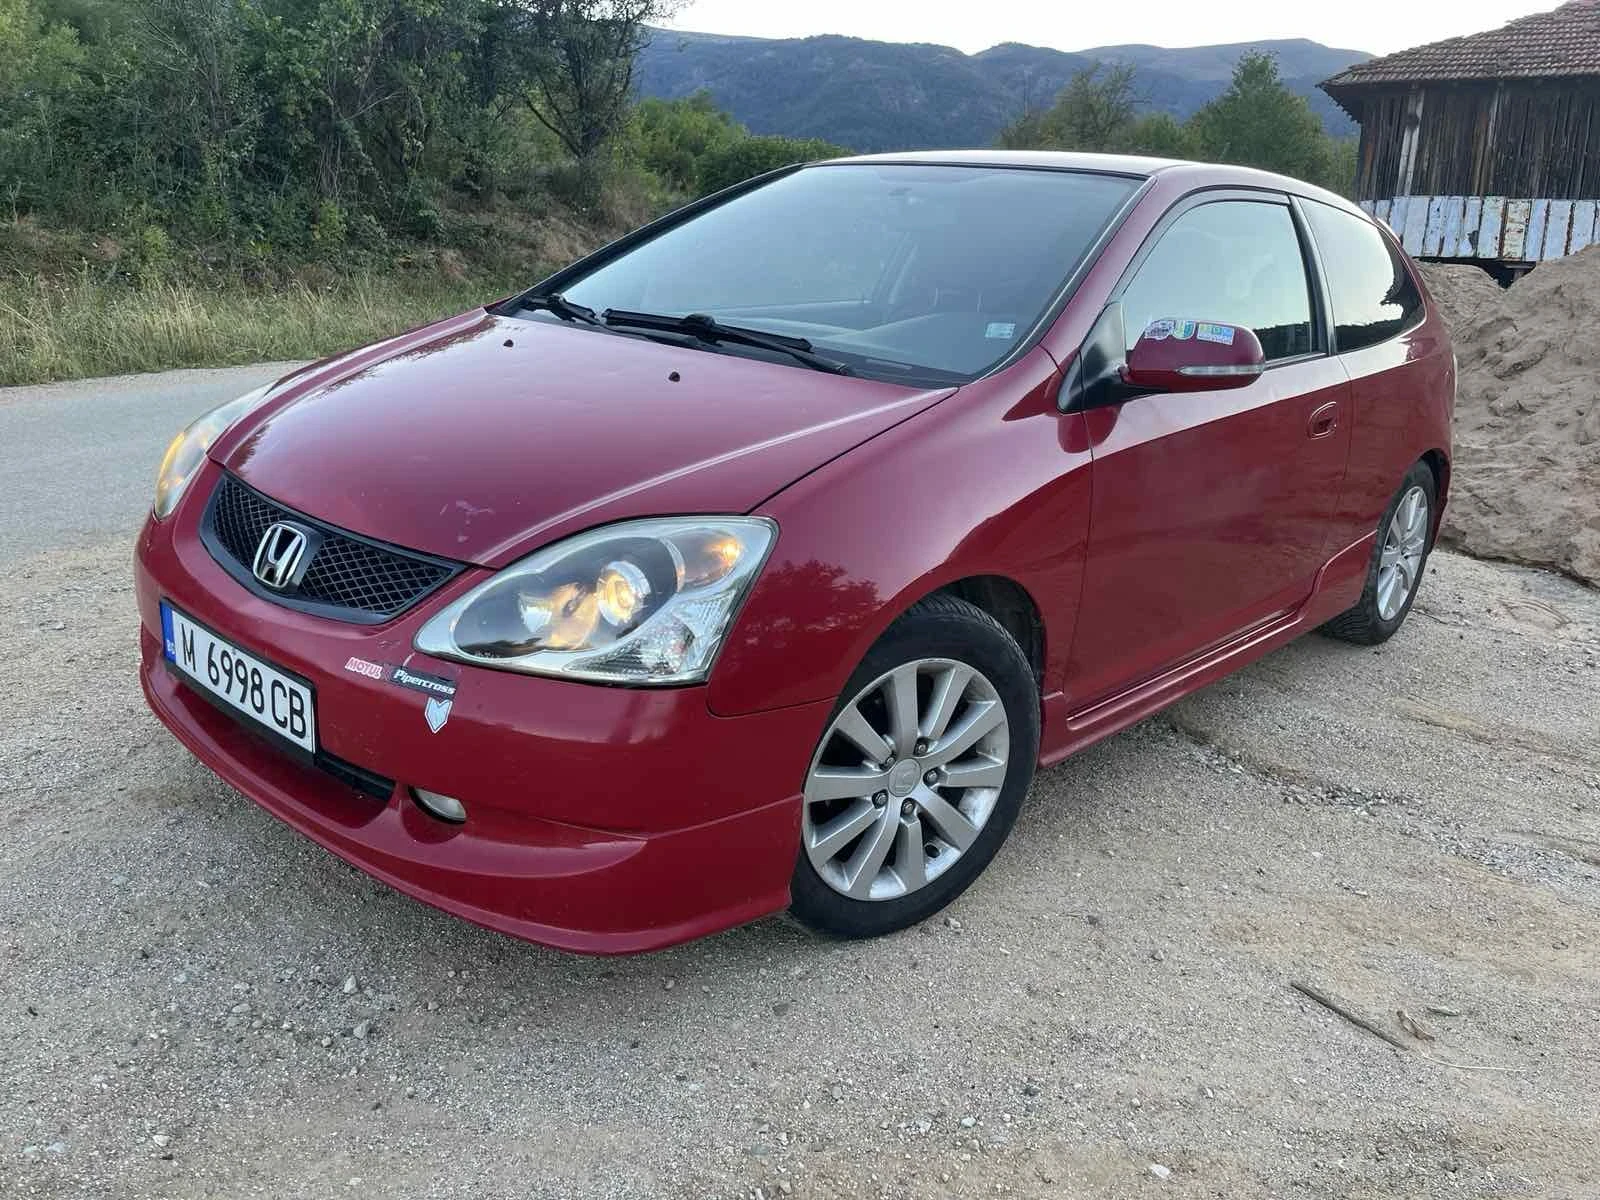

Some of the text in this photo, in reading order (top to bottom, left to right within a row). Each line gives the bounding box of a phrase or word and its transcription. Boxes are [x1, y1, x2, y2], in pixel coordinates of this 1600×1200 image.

[181, 623, 307, 739] M 6998 CB
[346, 658, 382, 678] MOTUL
[393, 669, 457, 695] Pipercross
